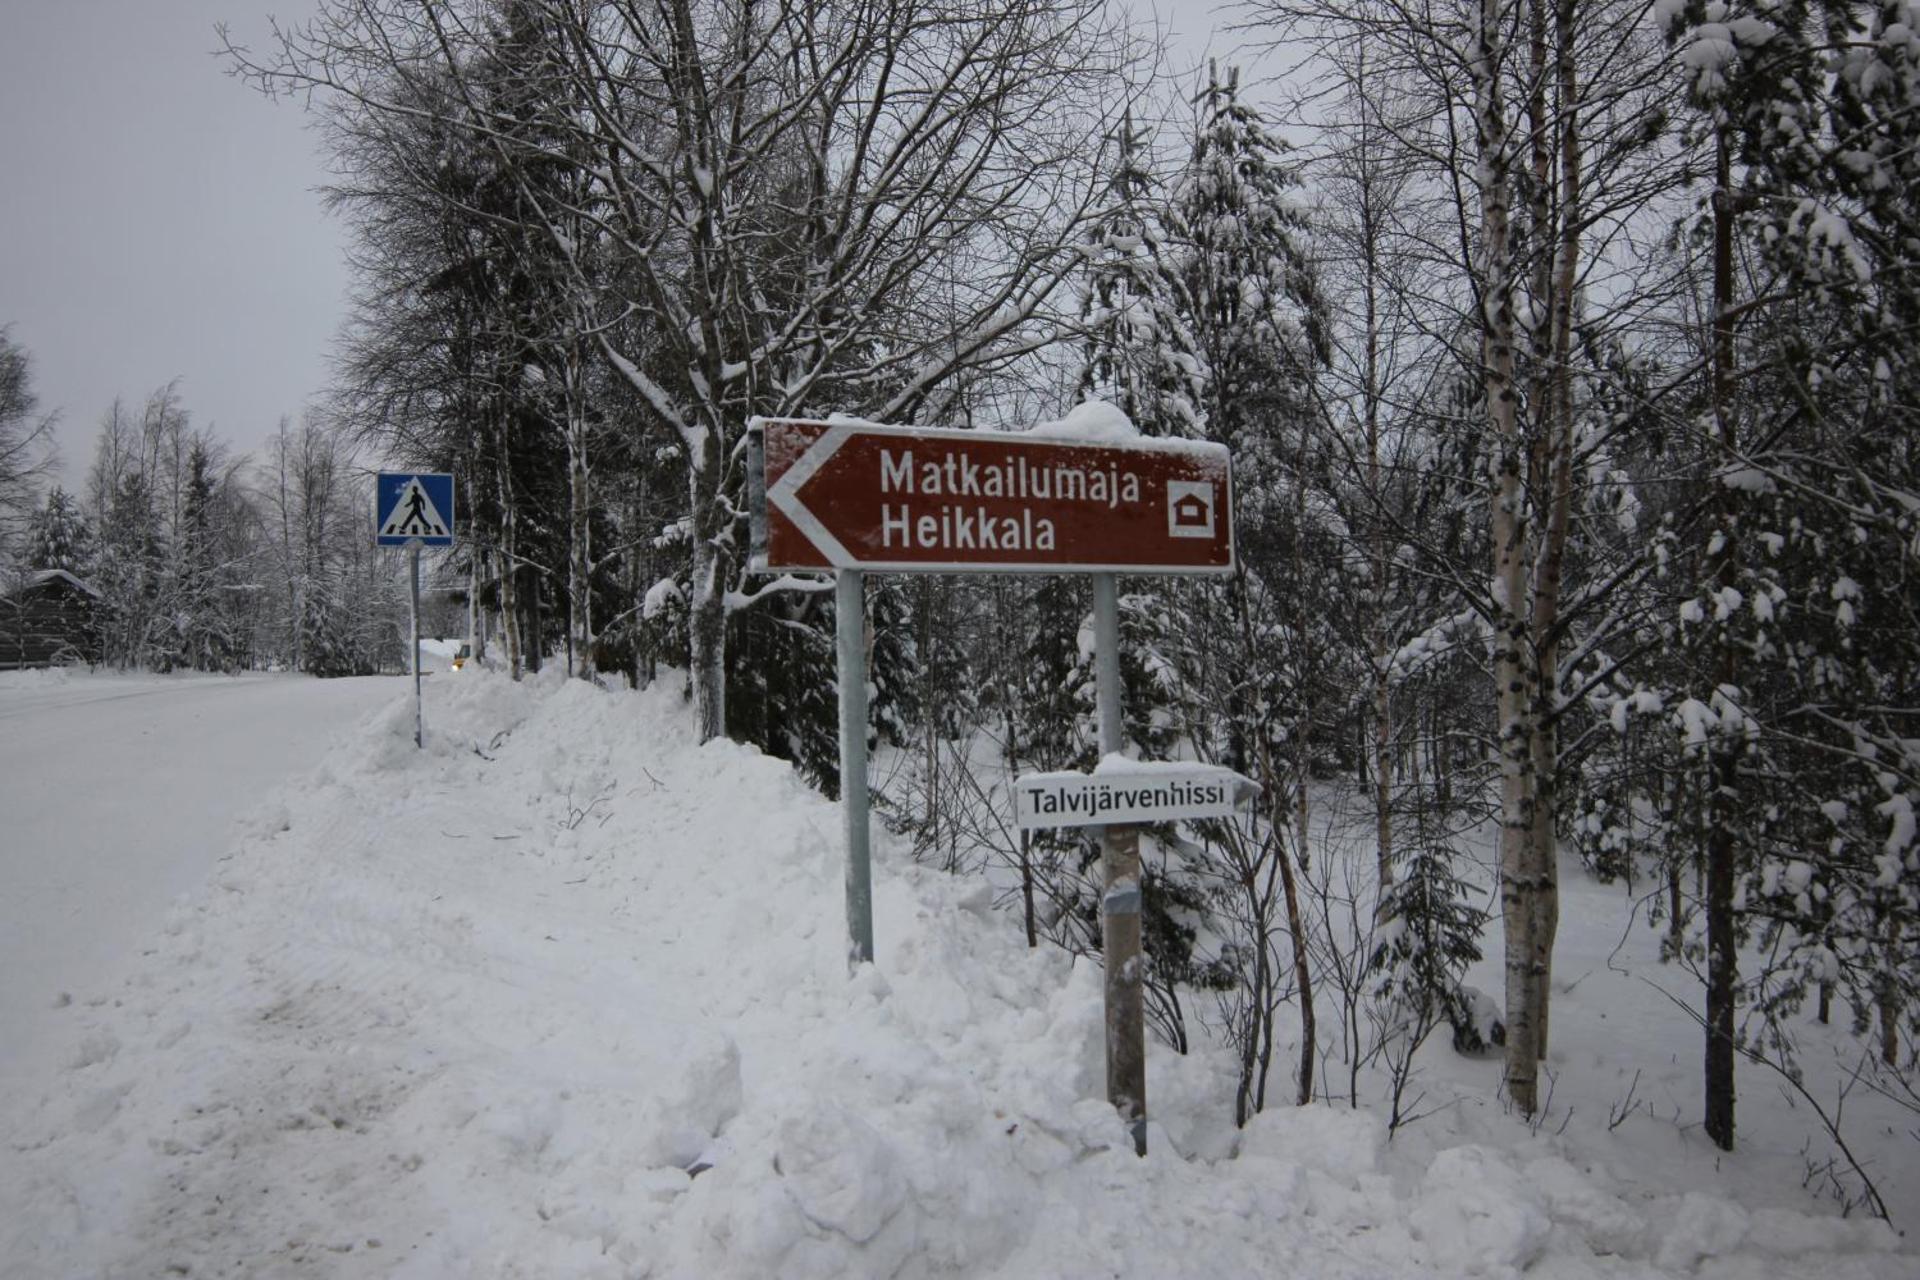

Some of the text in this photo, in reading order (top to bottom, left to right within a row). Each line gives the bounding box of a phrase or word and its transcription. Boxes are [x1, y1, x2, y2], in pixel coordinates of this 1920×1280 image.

[880, 449, 1139, 508] Matkailumaja
[882, 504, 1055, 549] Heikkala
[1028, 780, 1224, 816] Talvijärvenhissi
